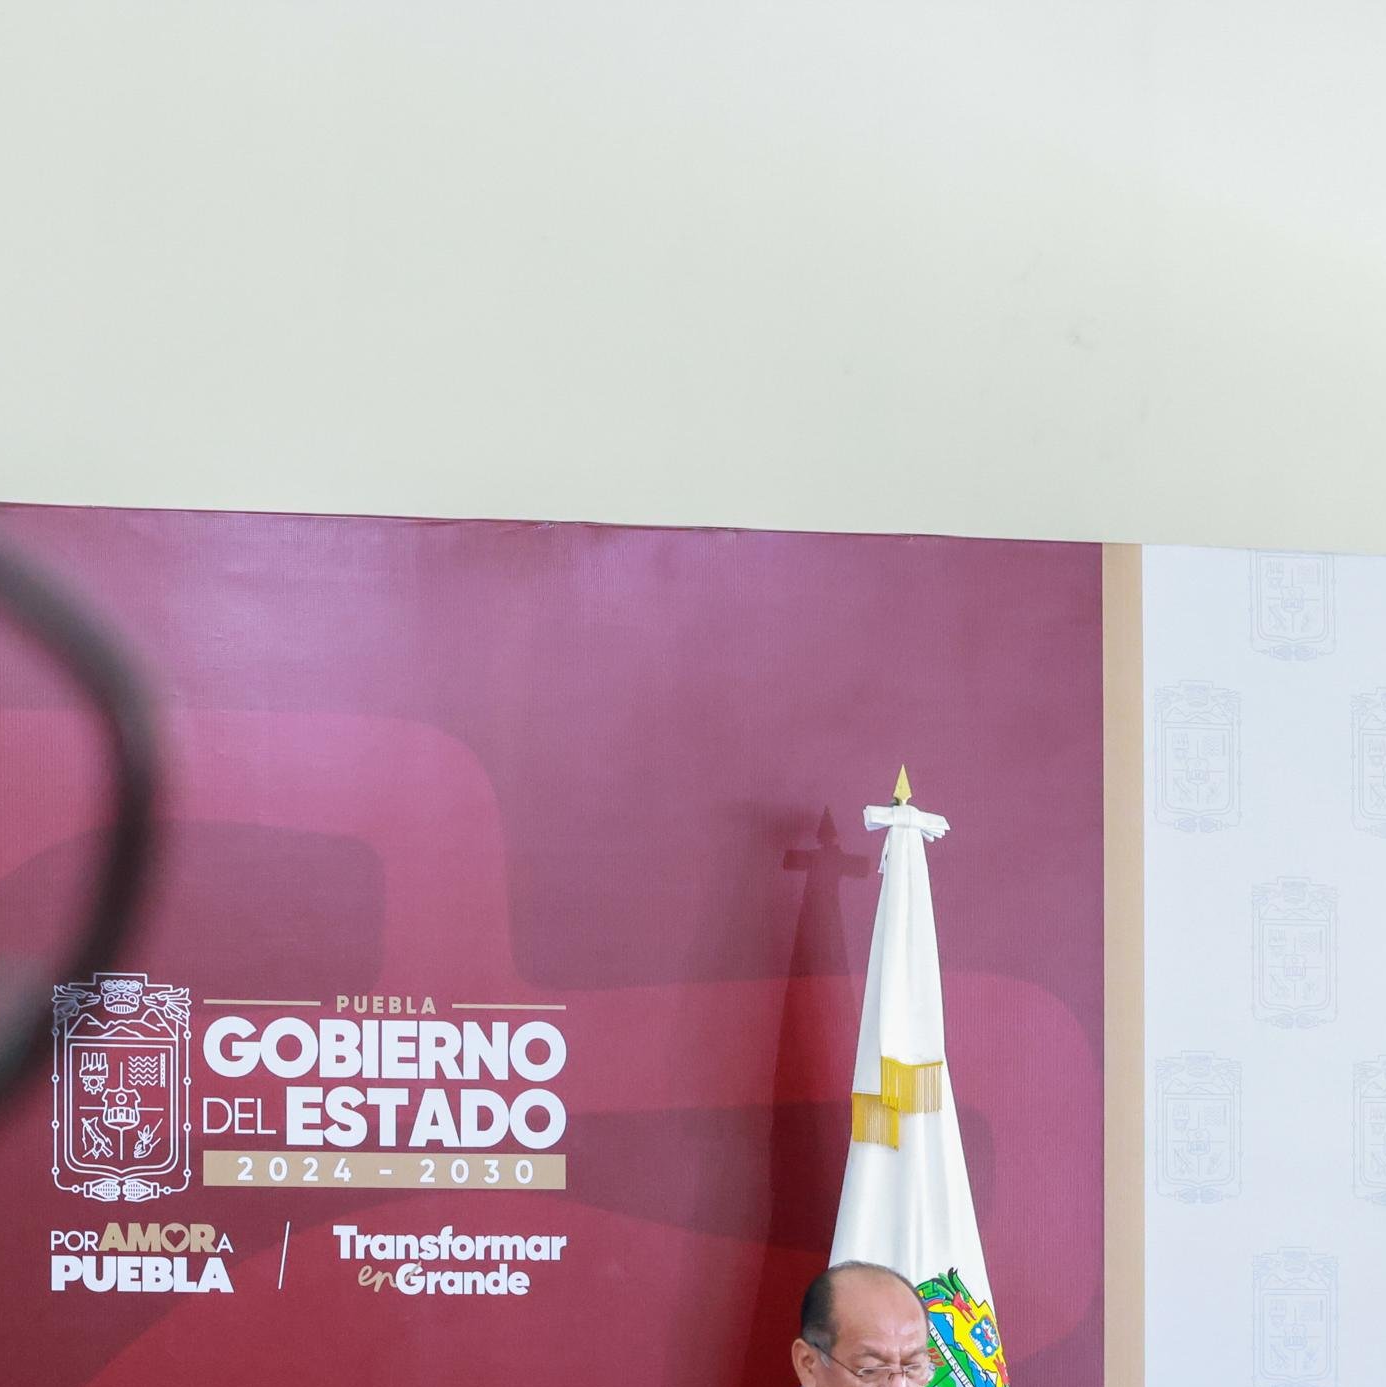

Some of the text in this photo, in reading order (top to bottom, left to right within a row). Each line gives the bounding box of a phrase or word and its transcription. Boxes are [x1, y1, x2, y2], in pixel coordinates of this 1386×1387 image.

[336, 995, 437, 1014] PUEBLA
[203, 1015, 567, 1082] GOBIERNO
[203, 1086, 567, 1149] DEL ESTADO
[237, 1156, 352, 1183] 2024
[420, 1159, 534, 1184] 2030
[333, 1225, 567, 1261] Transformar
[50, 1255, 234, 1292] PUEBLA
[394, 1263, 530, 1296] Grande
